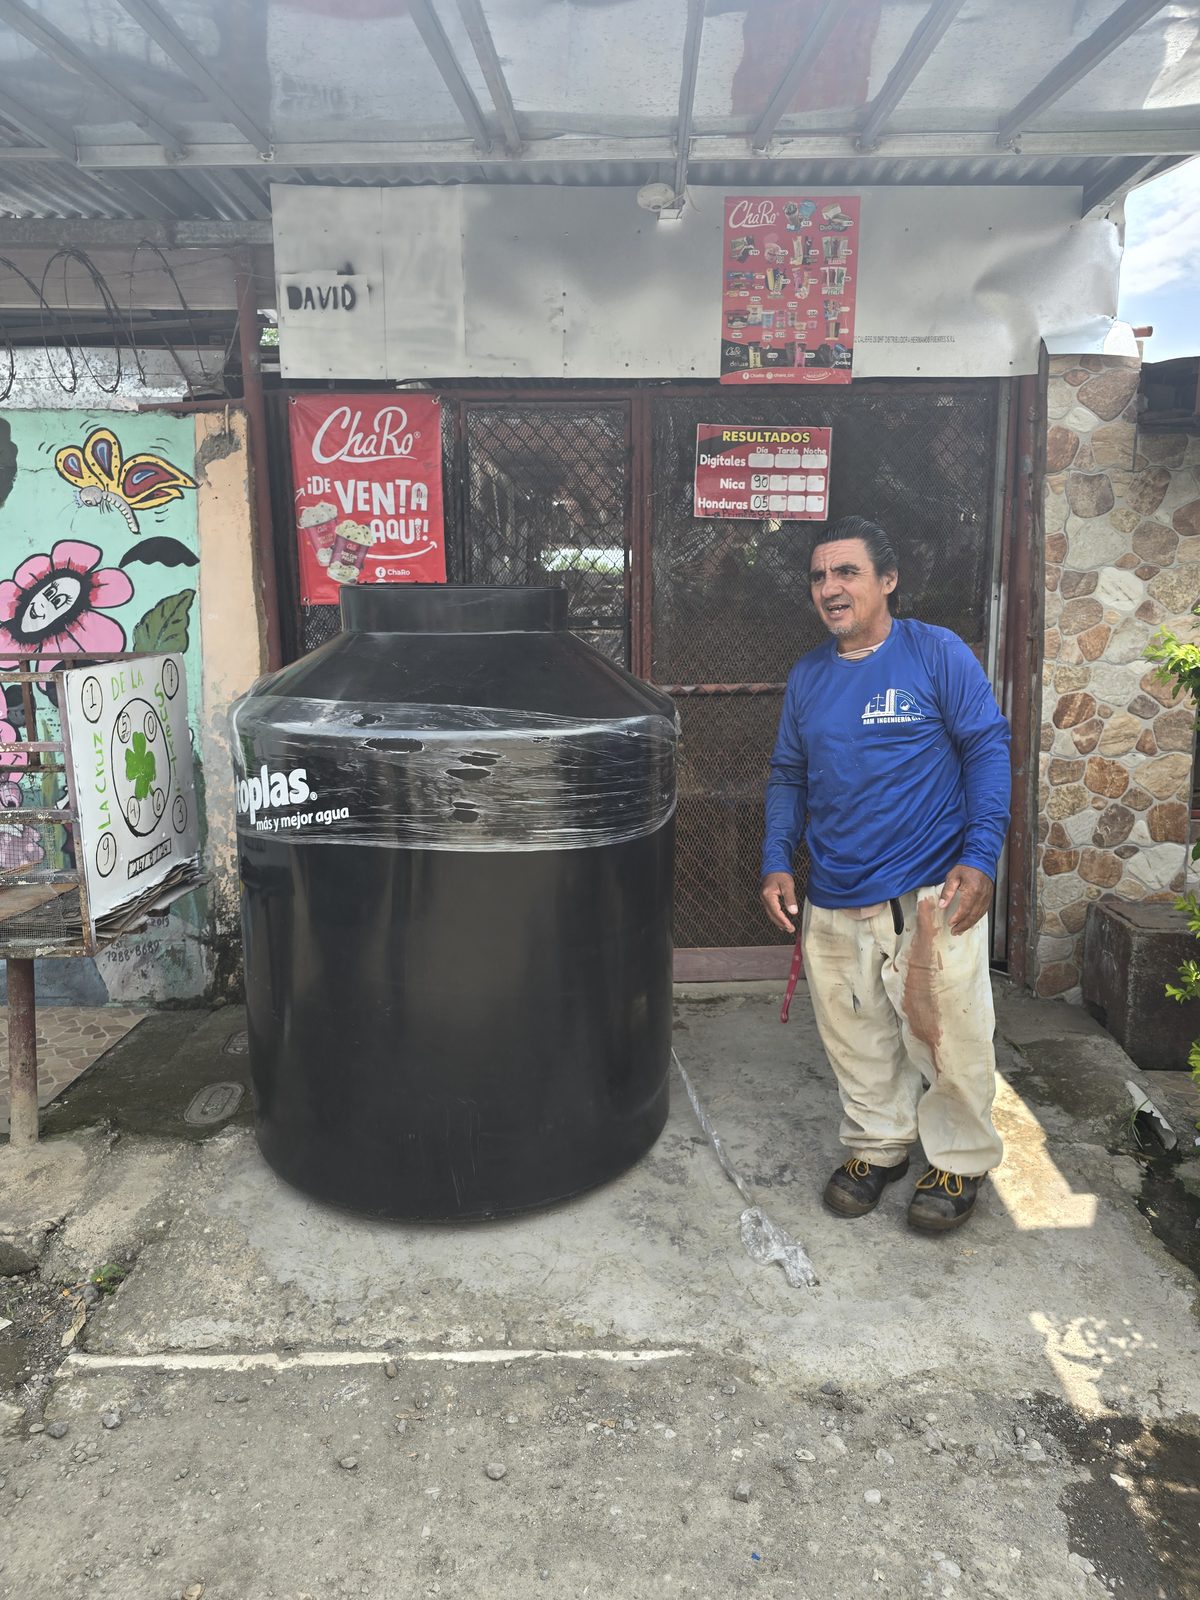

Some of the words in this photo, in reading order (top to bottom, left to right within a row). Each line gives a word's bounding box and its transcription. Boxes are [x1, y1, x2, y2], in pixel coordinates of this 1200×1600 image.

[729, 200, 777, 228] ChaRo
[286, 284, 356, 310] DAVID
[311, 406, 416, 464] ChaRo
[723, 431, 810, 443] RESULTADOS
[777, 447, 799, 455] Tarde
[803, 447, 827, 455] Noche
[700, 454, 746, 469] Digitales
[720, 479, 746, 490] Nica
[334, 479, 429, 516] VENTA
[698, 498, 748, 510] Honduras
[753, 496, 768, 509] 05
[387, 567, 411, 576] ChaRo
[111, 672, 126, 701] DE
[131, 671, 144, 690] LA
[98, 798, 112, 830] LA
[256, 816, 273, 831] más
[274, 817, 280, 832] y
[280, 811, 315, 830] mejor
[315, 806, 350, 825] agua
